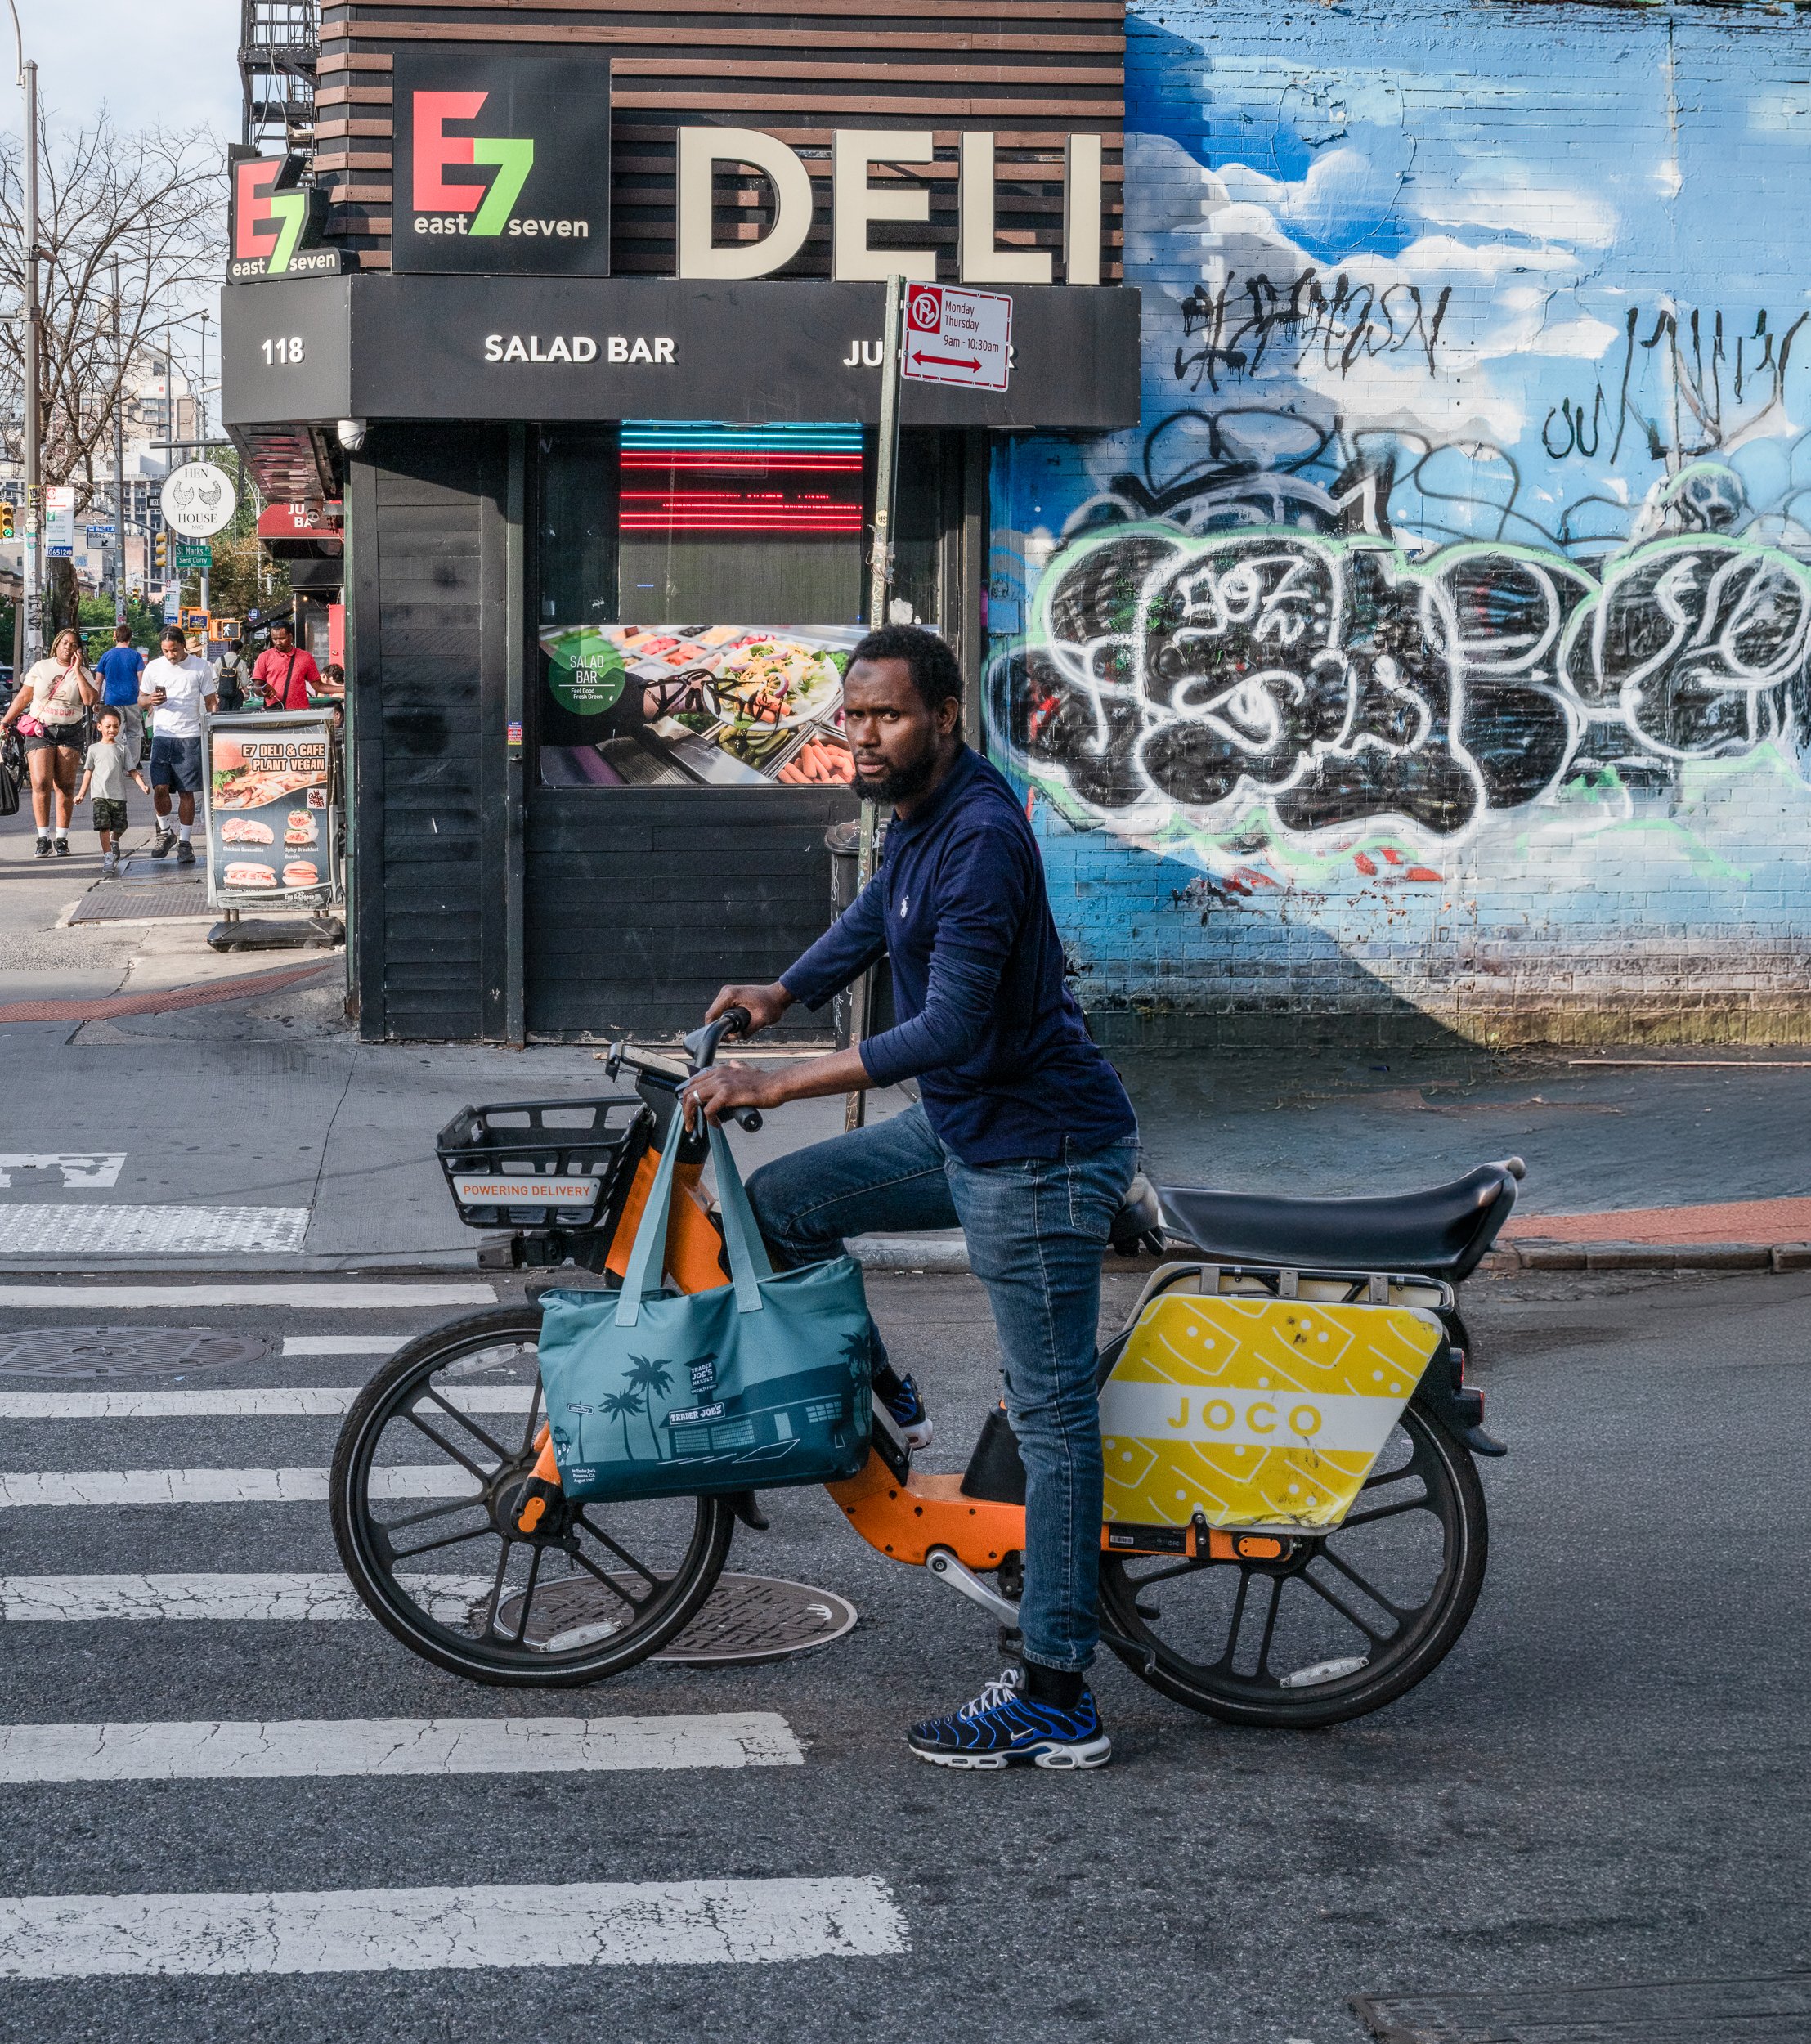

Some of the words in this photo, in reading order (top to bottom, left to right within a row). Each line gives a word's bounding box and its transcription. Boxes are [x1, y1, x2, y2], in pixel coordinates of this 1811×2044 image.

[677, 126, 1102, 286] DELI
[414, 214, 468, 235] east
[509, 217, 589, 237] seven
[232, 258, 266, 276] east
[289, 253, 336, 271] seven
[945, 300, 975, 317] Monday
[944, 315, 979, 333] Thursday
[485, 334, 598, 362] SALAD
[607, 337, 676, 363] BAR
[944, 334, 961, 347] 9am
[967, 338, 999, 352] 10:30am
[262, 336, 304, 365] 118
[185, 468, 208, 478] HEN
[178, 513, 218, 524] HOUSE
[294, 516, 312, 528] BA
[177, 546, 184, 555] St
[186, 546, 204, 555] Marks
[192, 556, 208, 565] Curry
[570, 655, 604, 668] SALAD
[576, 670, 598, 684] BAR
[243, 743, 257, 757] E7
[259, 743, 283, 757] DELI
[285, 743, 296, 757] &
[298, 743, 325, 757] CAFE
[252, 758, 288, 772] PLANT
[290, 758, 325, 772] VEGAN
[463, 1185, 528, 1196] POWERING
[531, 1186, 590, 1197] DELIVERY
[691, 1362, 712, 1374] TRADER
[692, 1369, 713, 1380] JOE'S
[692, 1376, 713, 1386] MARKET
[670, 1410, 699, 1422] TRADER
[699, 1405, 722, 1418] JOE'S
[1167, 1397, 1323, 1437] JOCO
